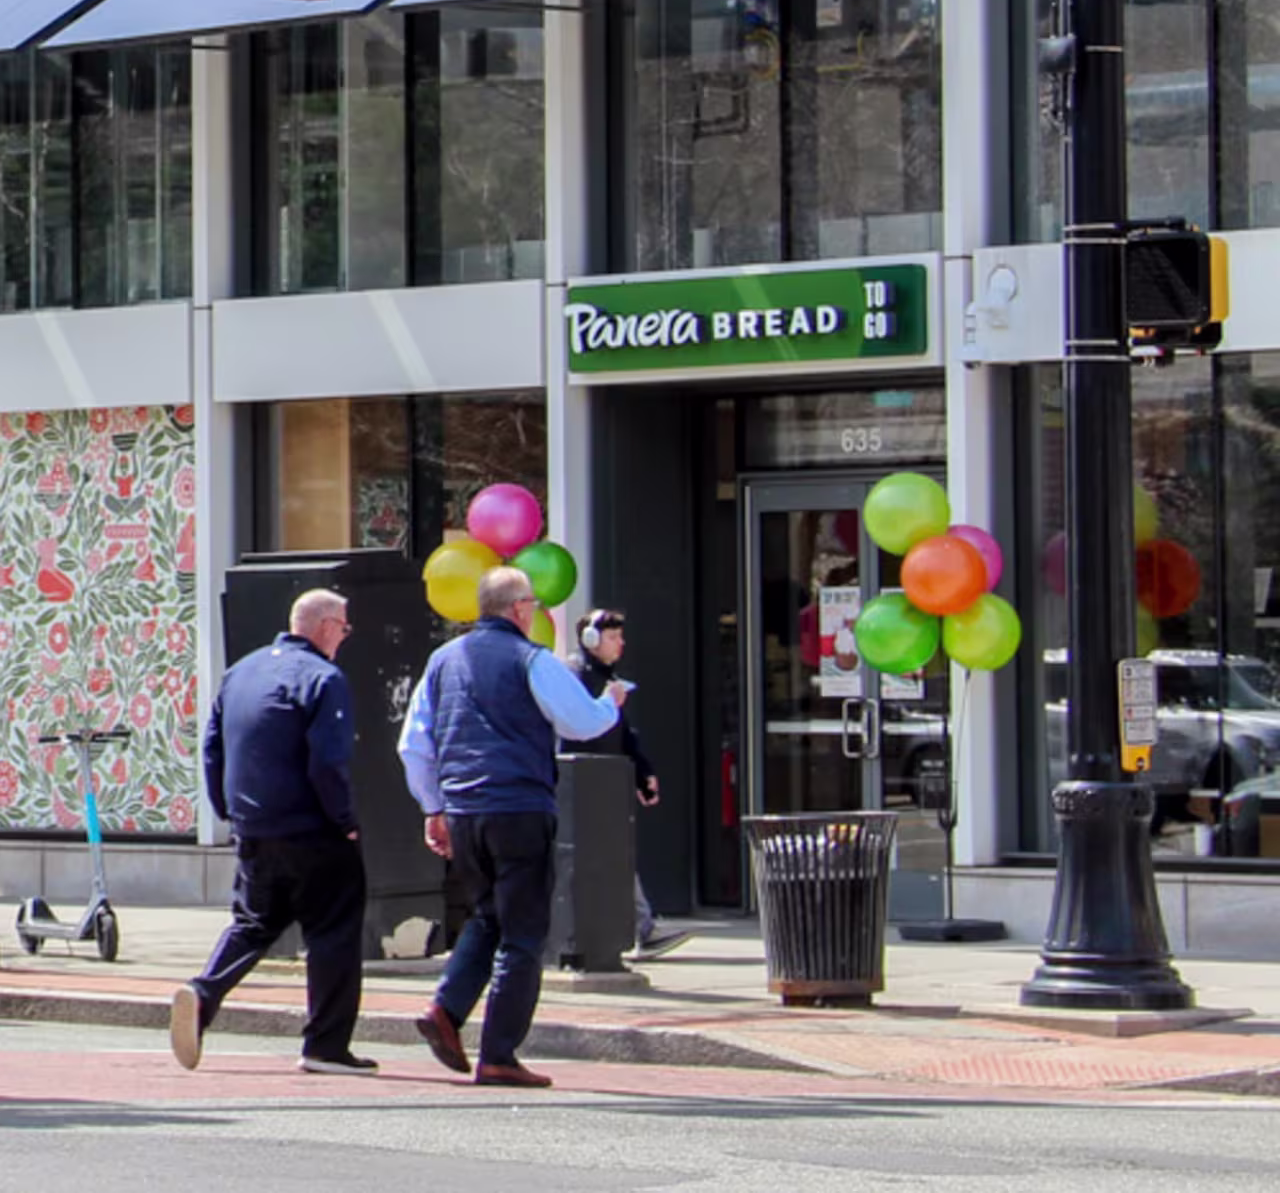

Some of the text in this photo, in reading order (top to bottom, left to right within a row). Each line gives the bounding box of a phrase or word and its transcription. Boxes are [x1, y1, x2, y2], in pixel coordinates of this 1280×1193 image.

[862, 281, 887, 308] TO
[563, 303, 839, 354] Panera BREAD
[863, 312, 887, 339] GO
[841, 427, 882, 454] 635
